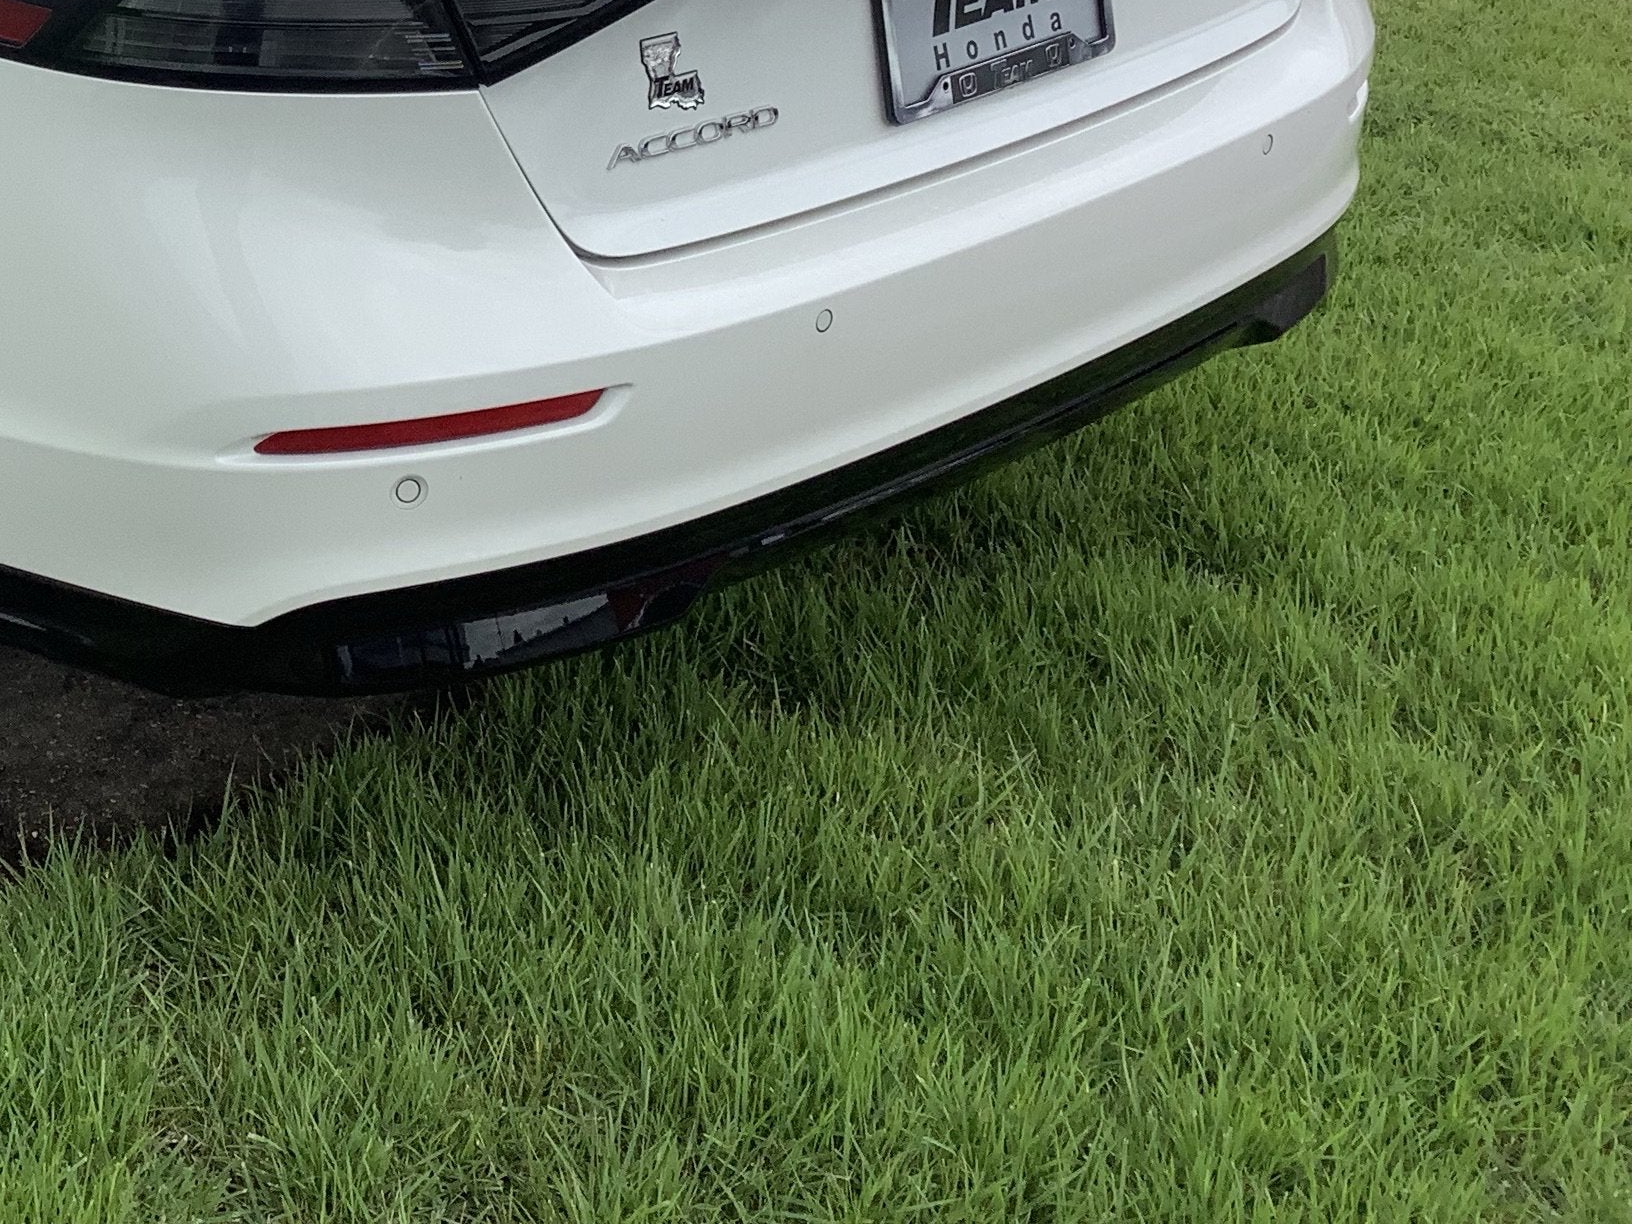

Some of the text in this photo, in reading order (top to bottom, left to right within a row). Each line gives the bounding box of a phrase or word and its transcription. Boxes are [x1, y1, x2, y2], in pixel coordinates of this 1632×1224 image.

[933, 11, 1062, 71] Honda
[654, 75, 695, 99] TEAM
[606, 104, 779, 171] ACCORD
